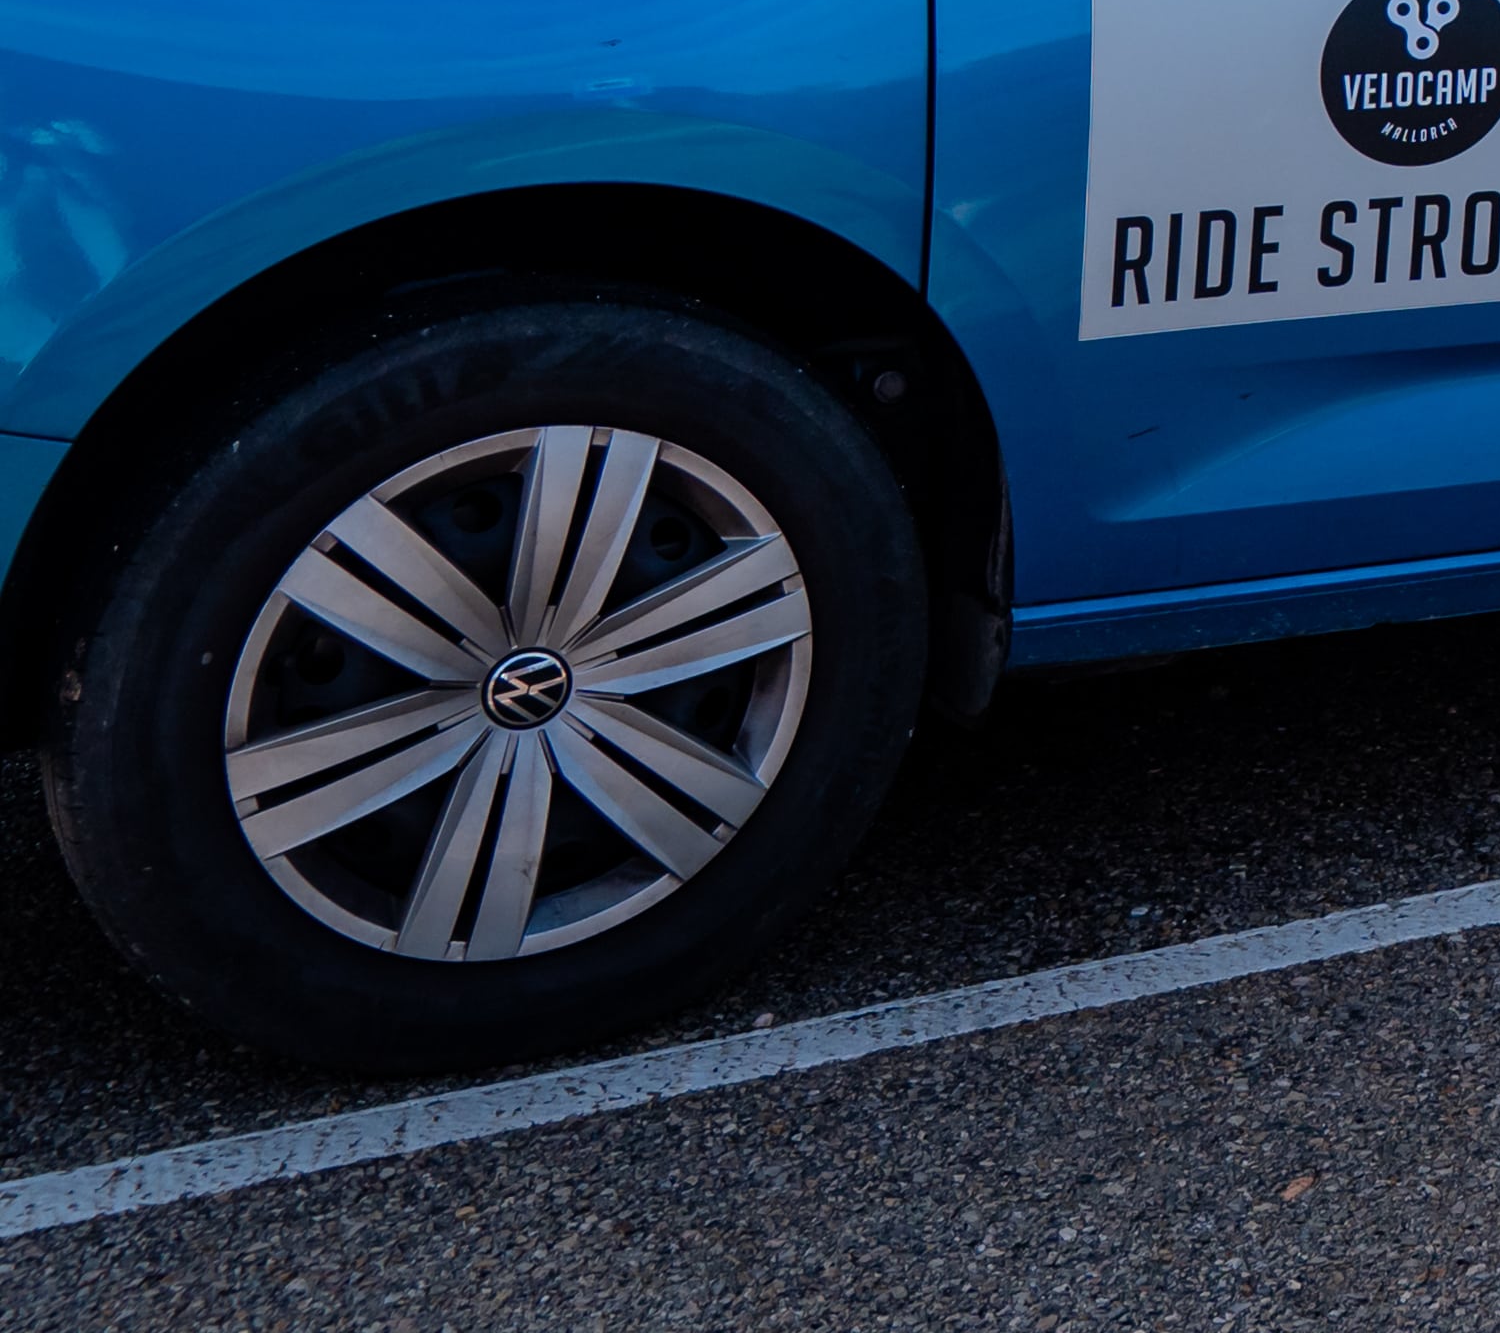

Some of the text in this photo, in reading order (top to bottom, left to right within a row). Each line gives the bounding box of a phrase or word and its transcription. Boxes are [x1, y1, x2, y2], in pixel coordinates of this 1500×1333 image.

[1343, 66, 1498, 110] VELOCAMP
[1381, 116, 1459, 143] MALLORCA
[1111, 204, 1284, 308] RIDE
